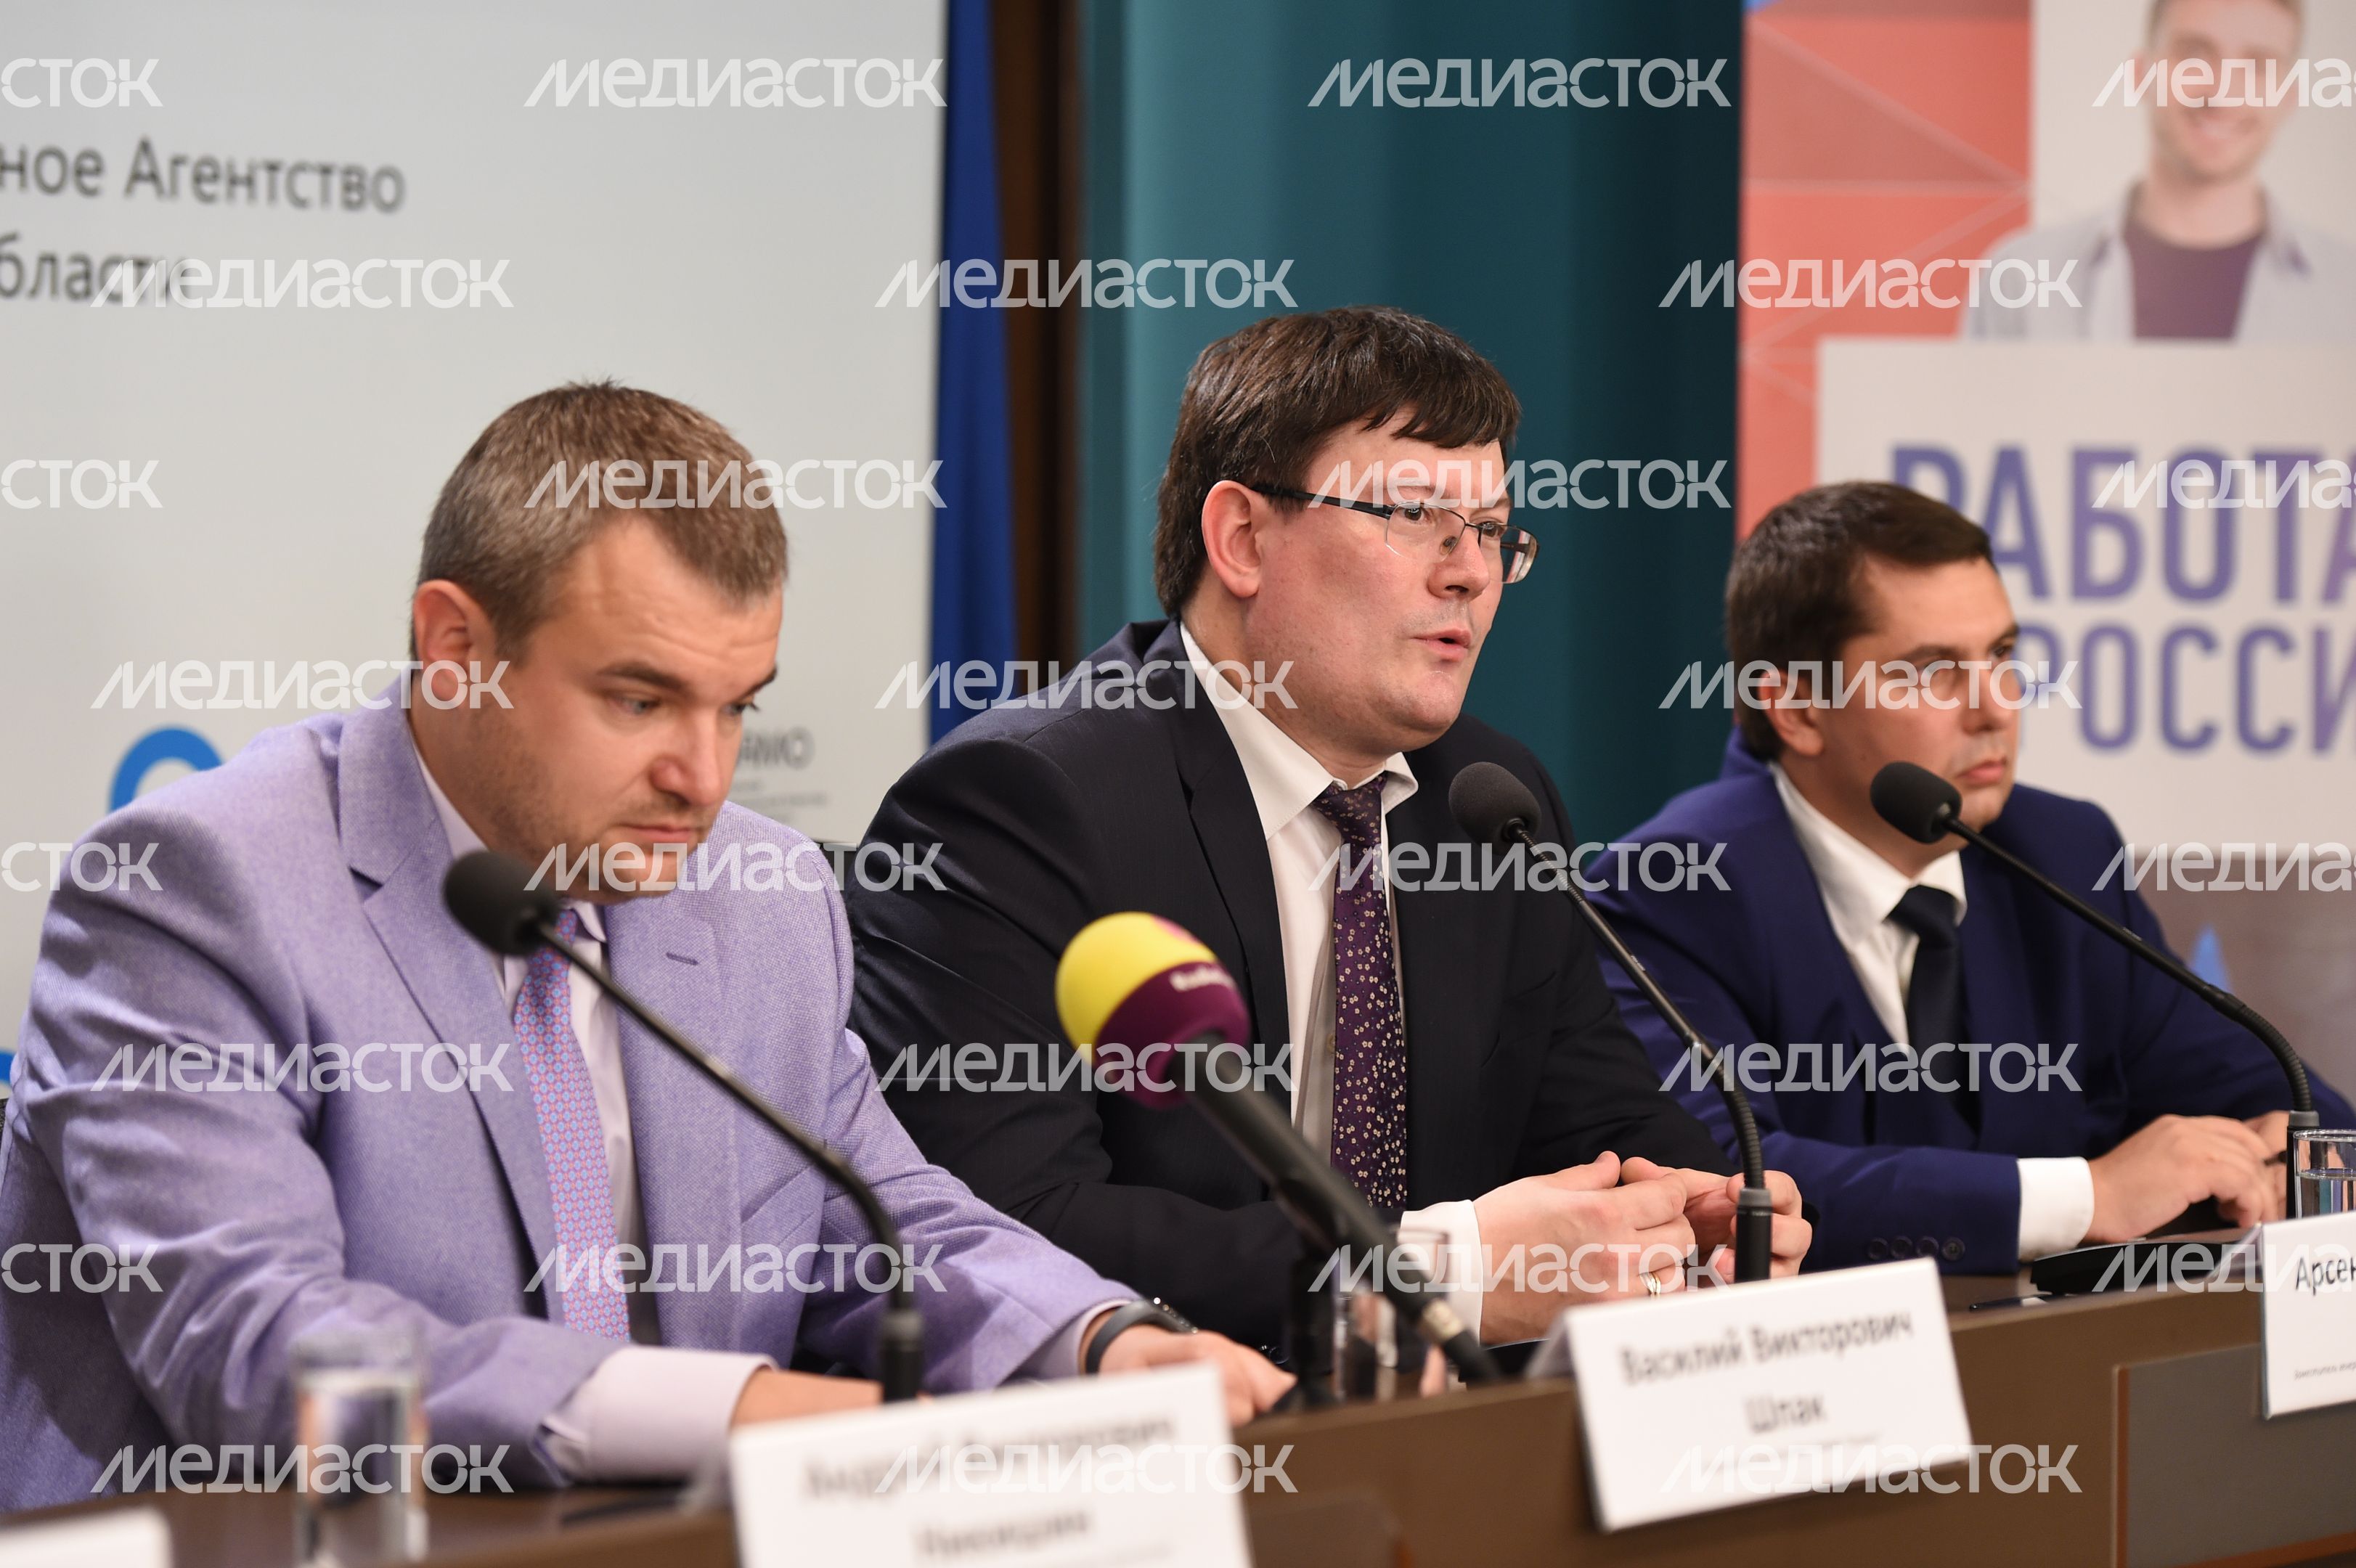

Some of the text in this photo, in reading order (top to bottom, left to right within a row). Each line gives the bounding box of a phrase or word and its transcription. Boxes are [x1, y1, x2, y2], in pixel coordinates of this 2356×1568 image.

[123, 135, 407, 213] Агентство
[1620, 1312, 1914, 1384] Василий Викторович
[1746, 1395, 1827, 1434] Шпак
